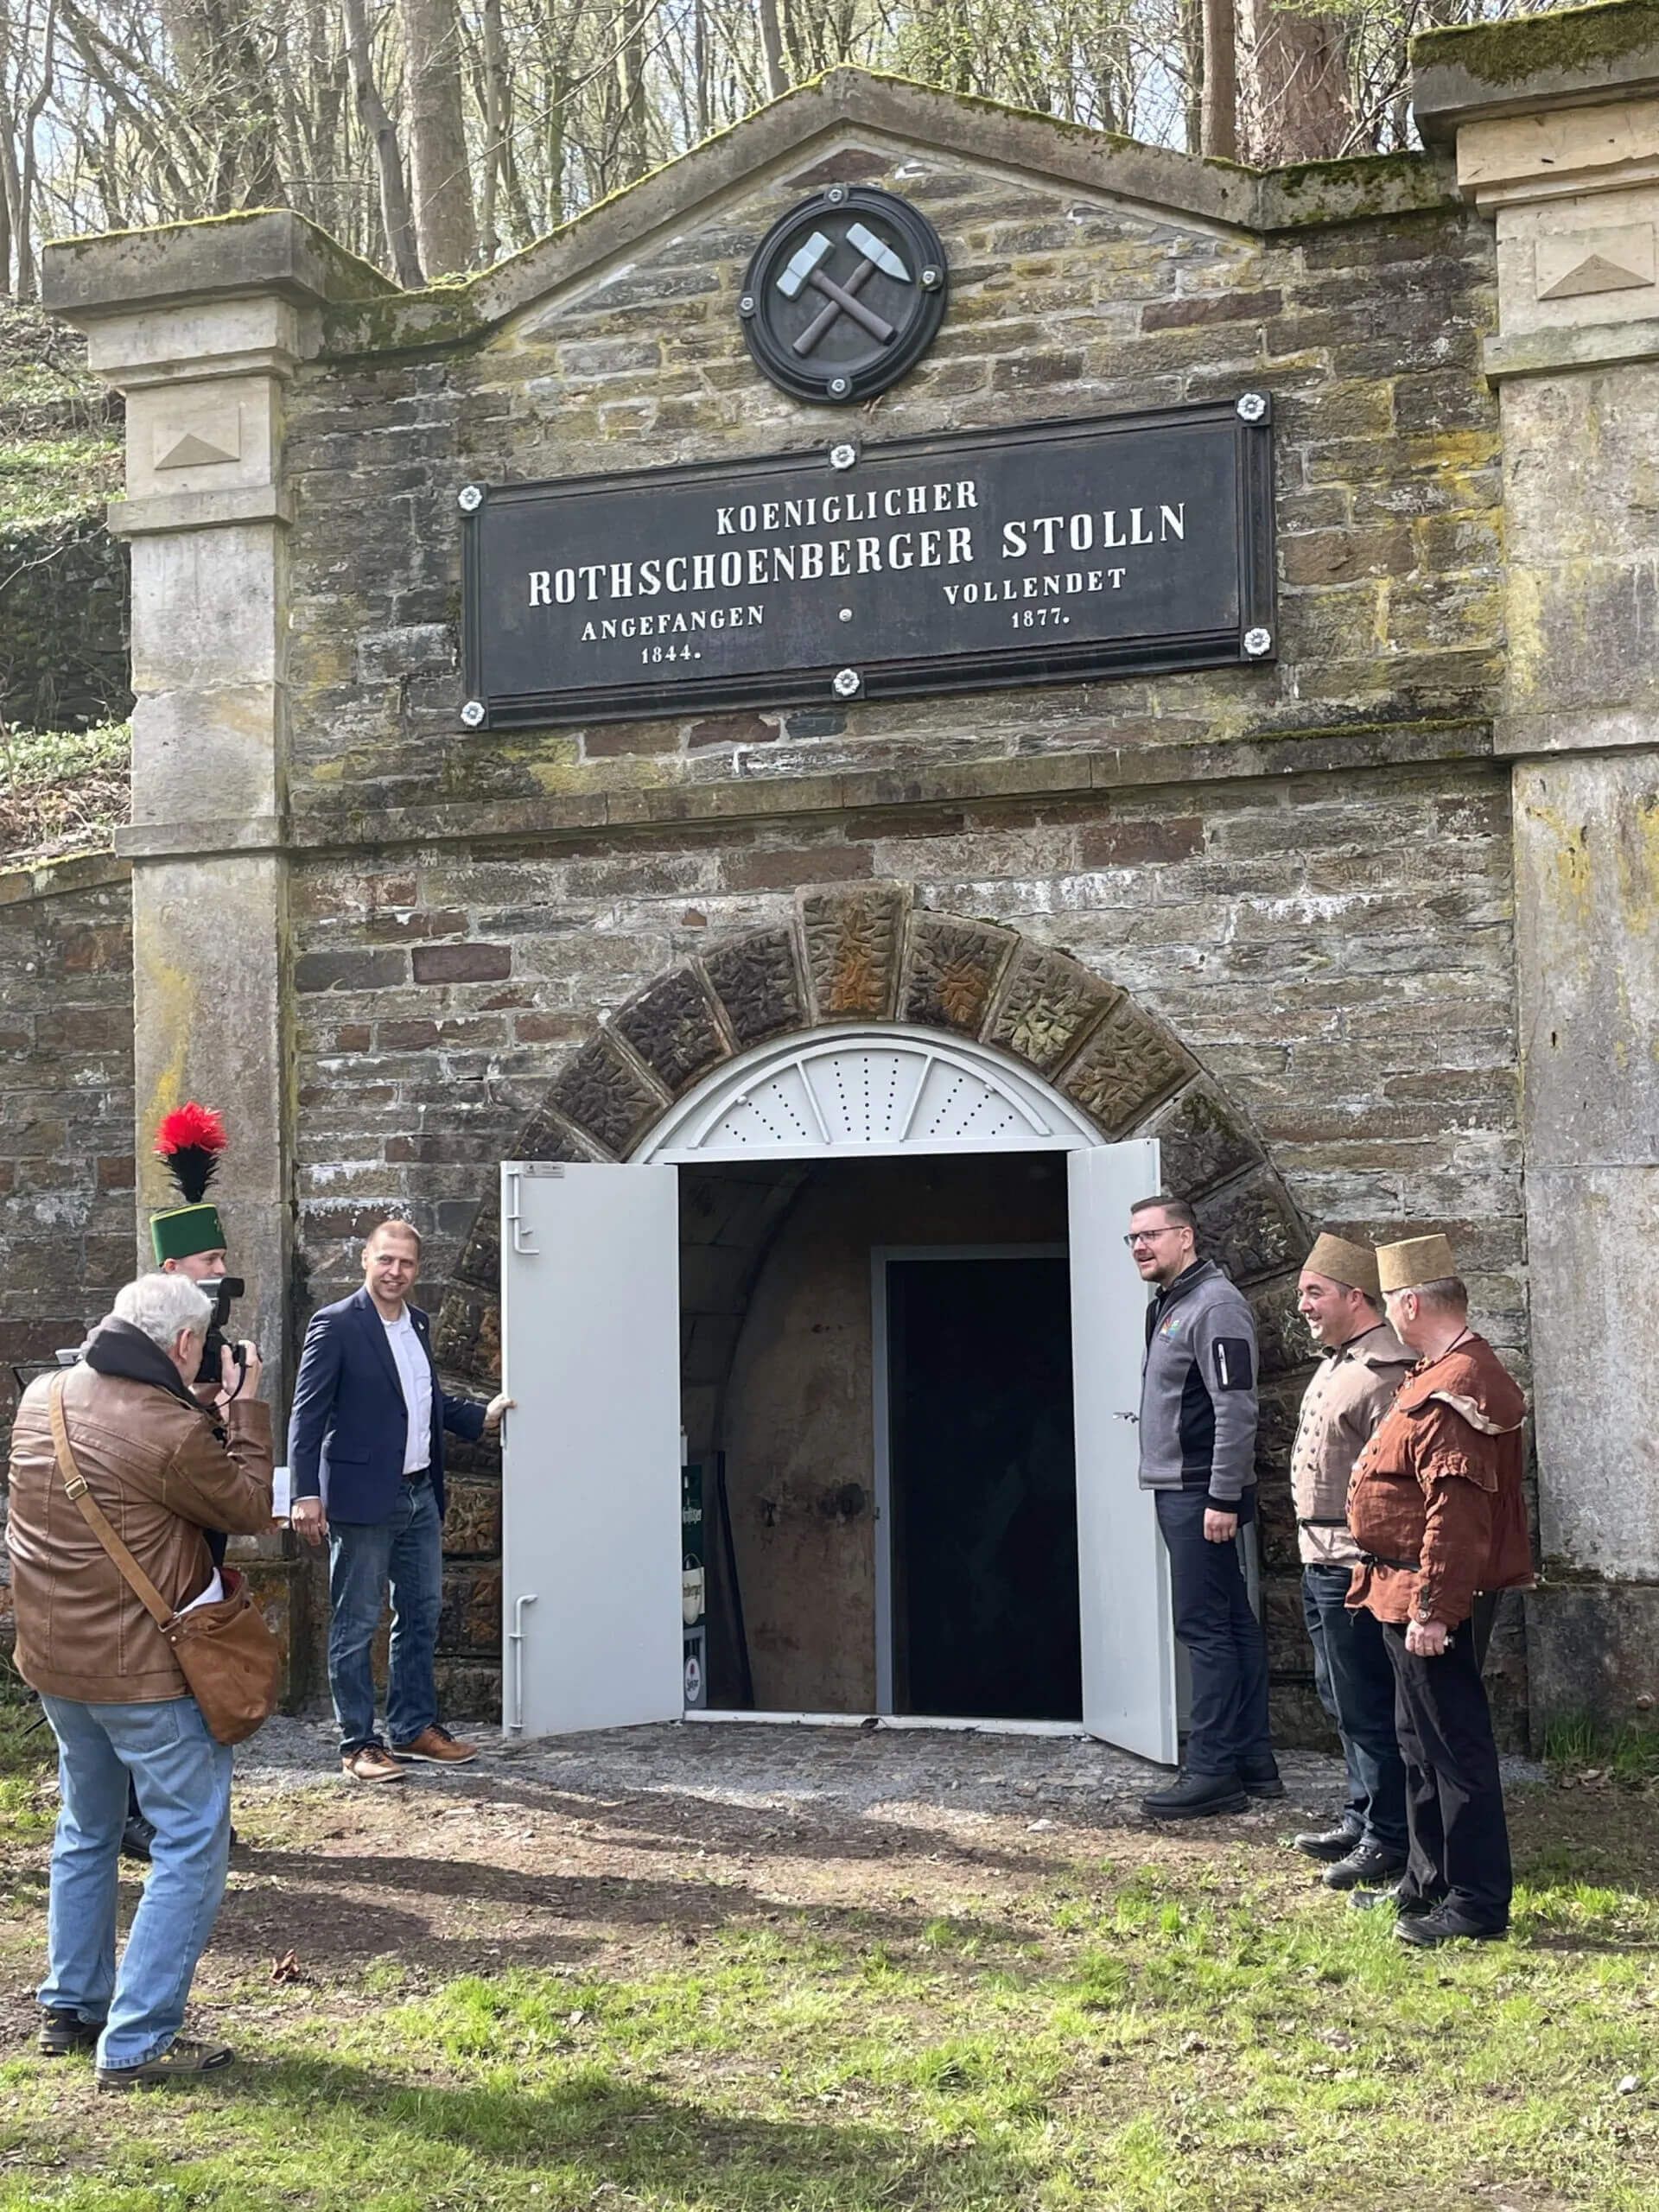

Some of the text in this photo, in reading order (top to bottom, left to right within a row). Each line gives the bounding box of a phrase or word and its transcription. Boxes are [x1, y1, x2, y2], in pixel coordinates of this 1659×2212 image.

[716, 480, 979, 536] KOENIGLICHER
[528, 503, 1185, 607] ROTHSCHOENBERGER STOLLN
[943, 568, 1127, 605] VOLLENDET
[581, 605, 765, 641] ANGEFANGEN
[1012, 607, 1070, 628] 1877.
[641, 644, 702, 664] 1844.
